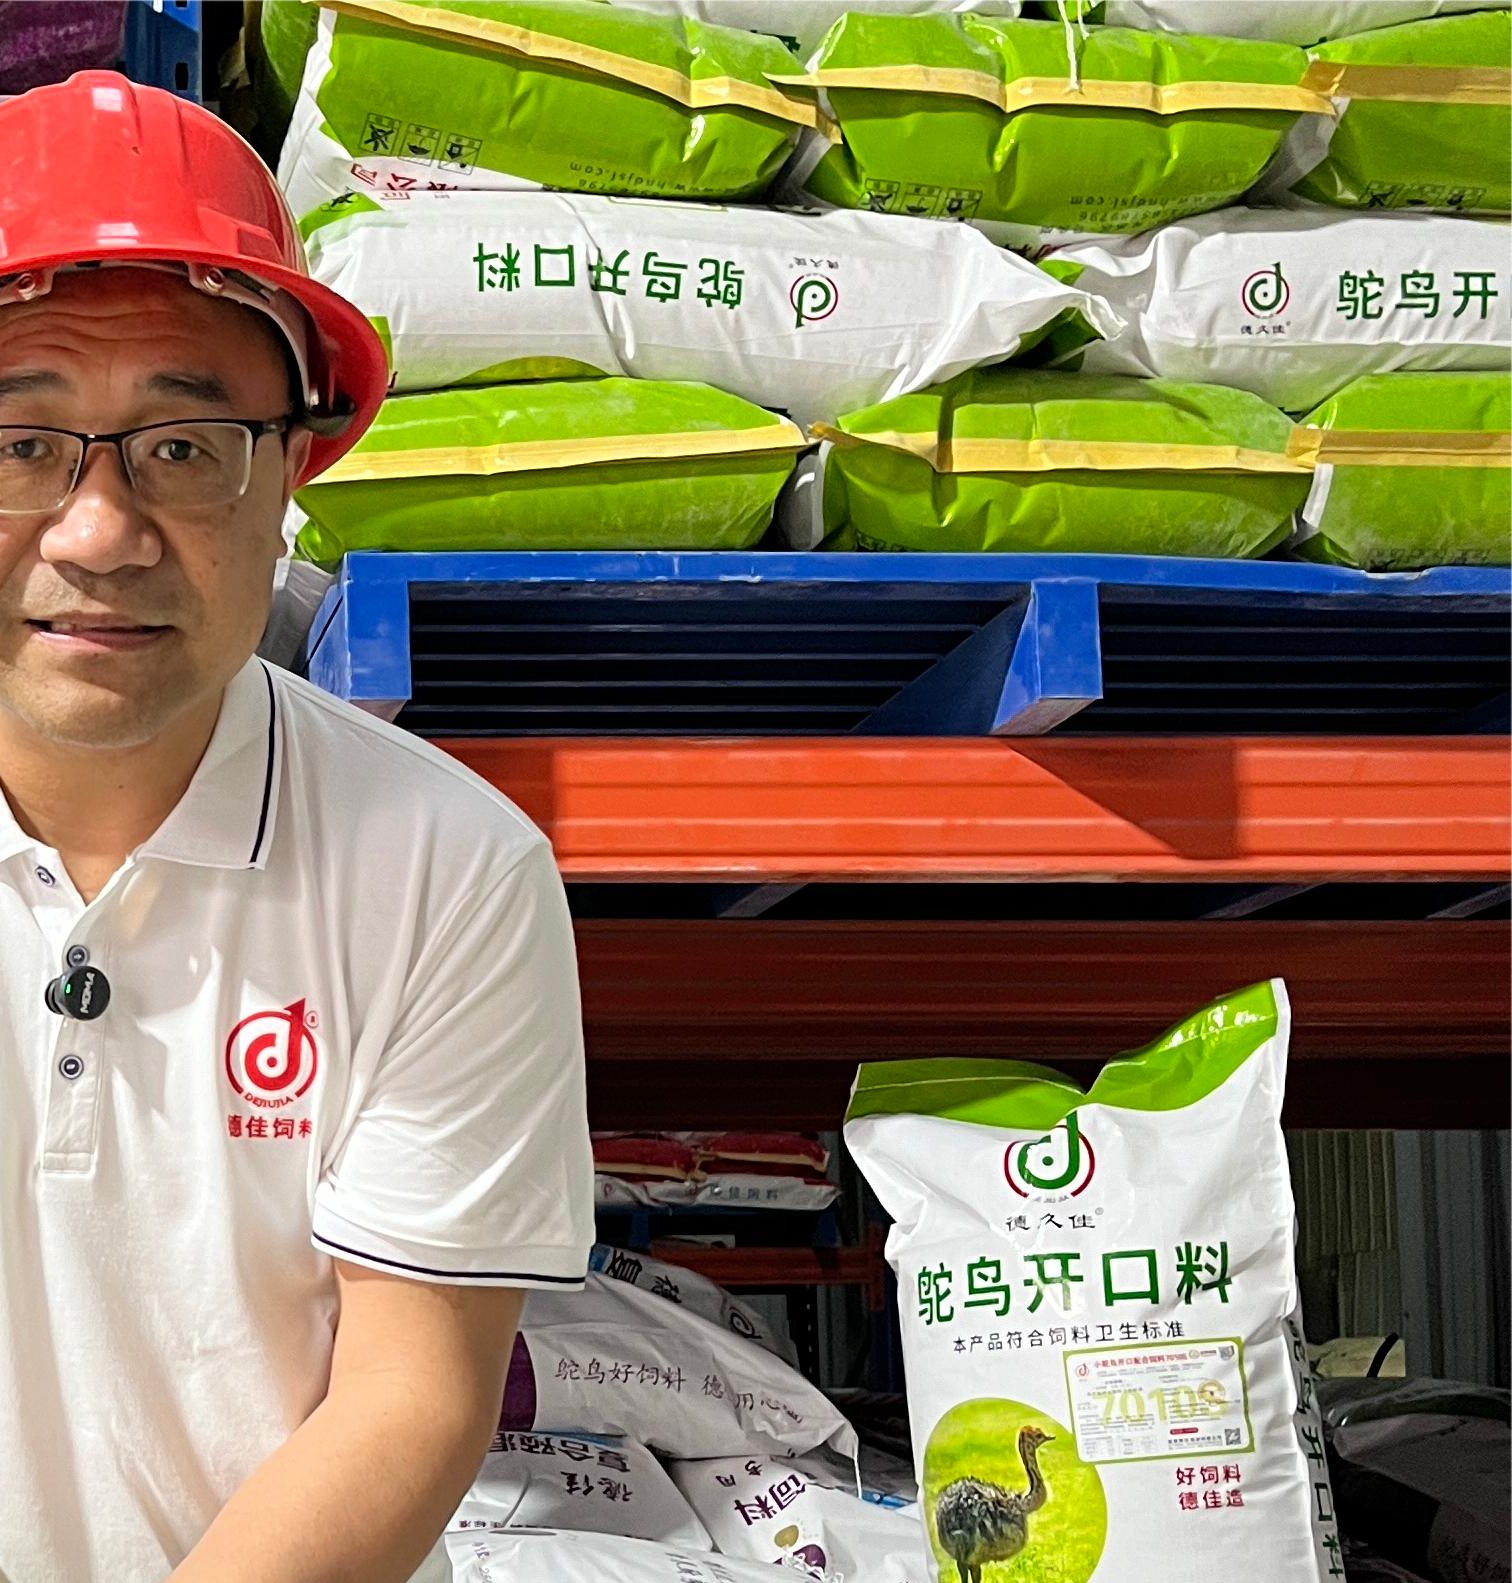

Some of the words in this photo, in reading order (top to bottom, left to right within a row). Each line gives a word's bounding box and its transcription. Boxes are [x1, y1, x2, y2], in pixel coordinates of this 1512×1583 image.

[473, 242, 746, 310] 鸵鸟开口料
[1004, 1211, 1097, 1232] 德久佳
[916, 1240, 1233, 1326] 鸵鸟开口料
[952, 1320, 1186, 1354] 本产品符合饲料卫生标准
[555, 1357, 687, 1395] 鸵鸟好饲料
[1175, 1463, 1242, 1486] 好饲料
[1178, 1489, 1245, 1511] 德佳造
